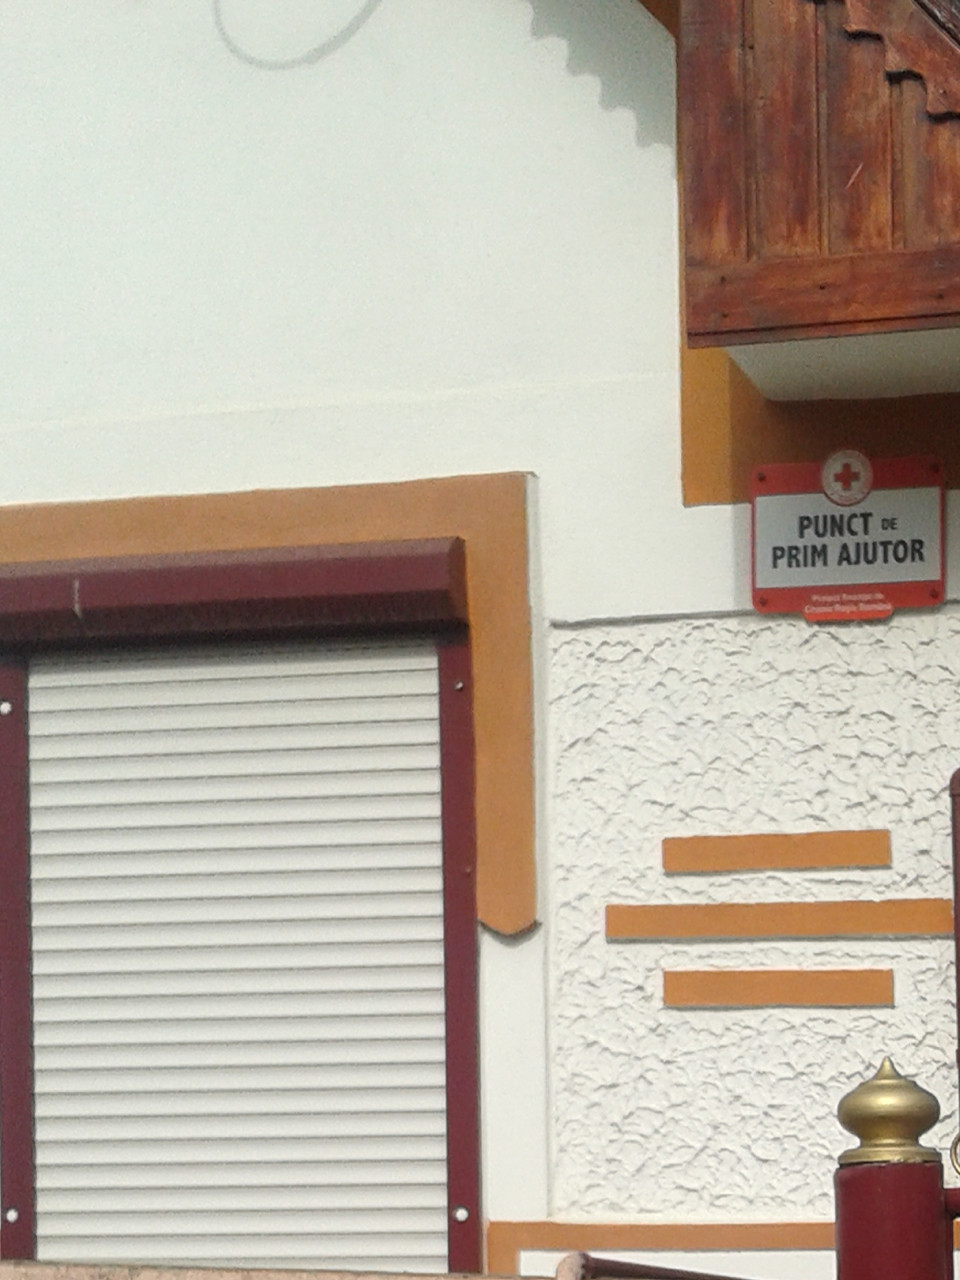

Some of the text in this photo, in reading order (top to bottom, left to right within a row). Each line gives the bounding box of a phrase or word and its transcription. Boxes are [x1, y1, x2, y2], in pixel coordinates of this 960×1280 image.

[798, 512, 898, 539] PUNCT DE
[772, 539, 925, 569] PRIM AJUTOR
